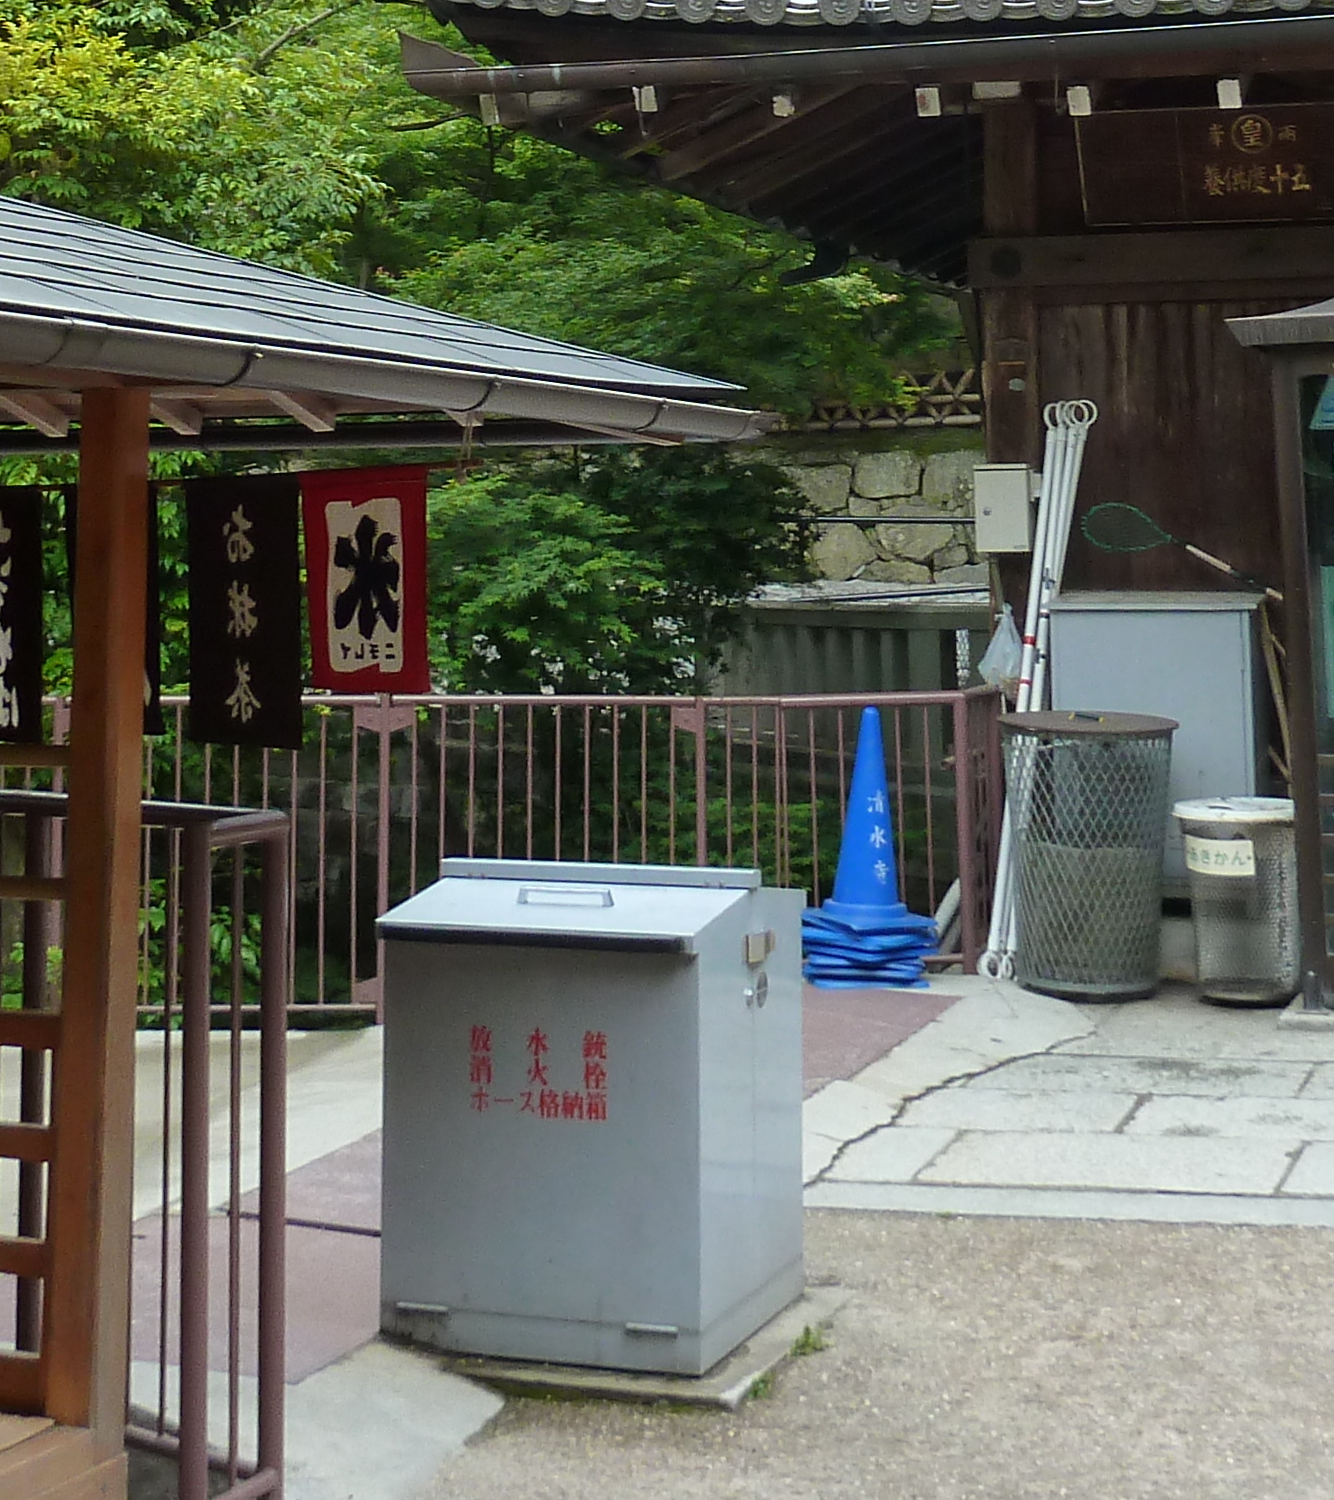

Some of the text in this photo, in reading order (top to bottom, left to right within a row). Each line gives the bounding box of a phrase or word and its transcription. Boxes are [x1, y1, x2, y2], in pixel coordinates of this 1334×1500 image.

[470, 1024, 608, 1059] 放水銃
[470, 1056, 608, 1090] 消火栓
[470, 1086, 608, 1121] ホース格納箱
